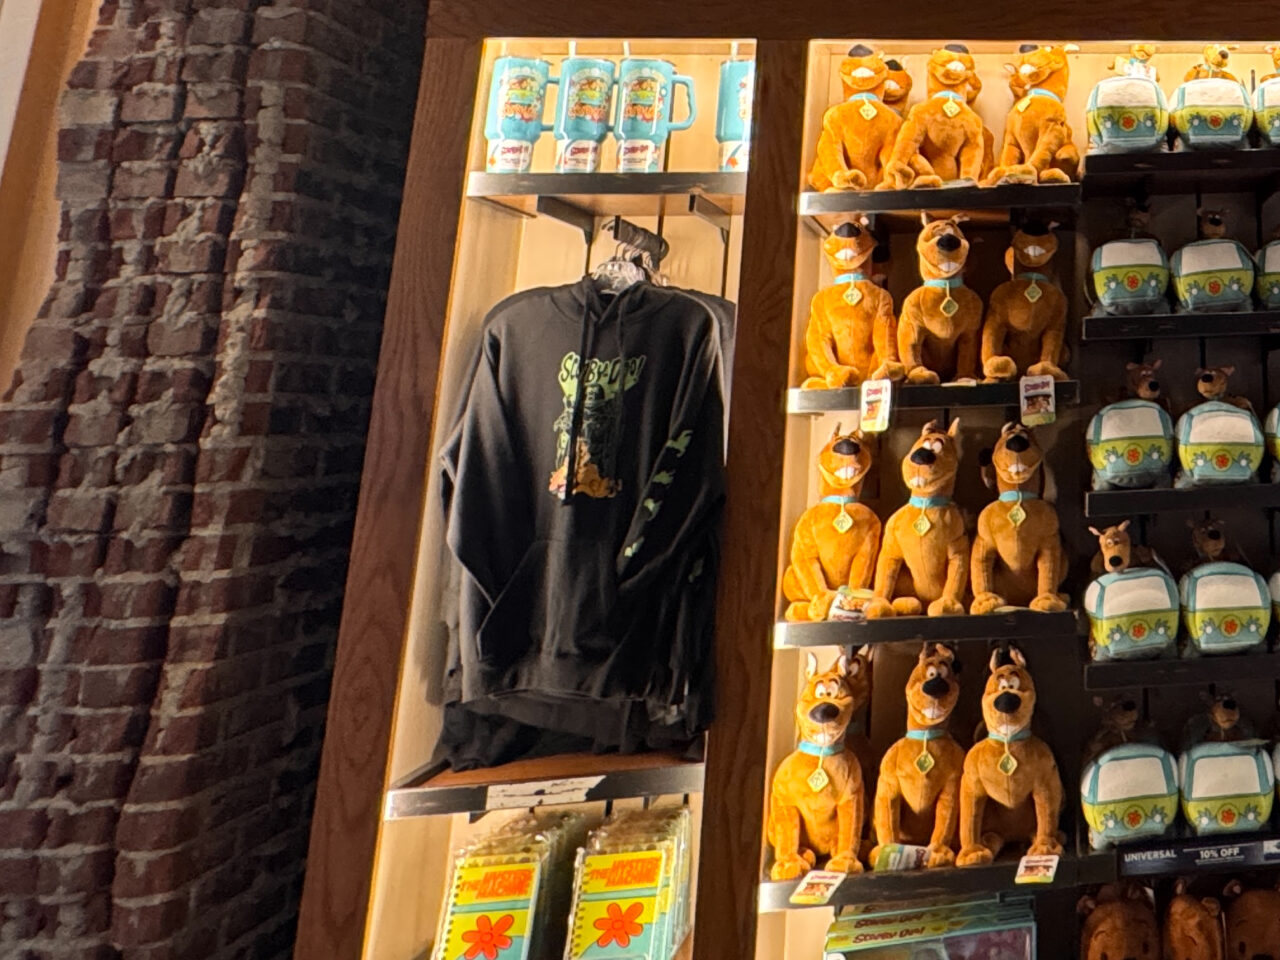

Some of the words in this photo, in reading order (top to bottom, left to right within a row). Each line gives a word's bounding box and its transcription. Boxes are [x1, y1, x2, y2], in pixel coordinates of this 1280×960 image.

[1124, 849, 1178, 862] UNIVERSAL
[1199, 849, 1218, 860] 10%
[1220, 847, 1240, 858] OFF
